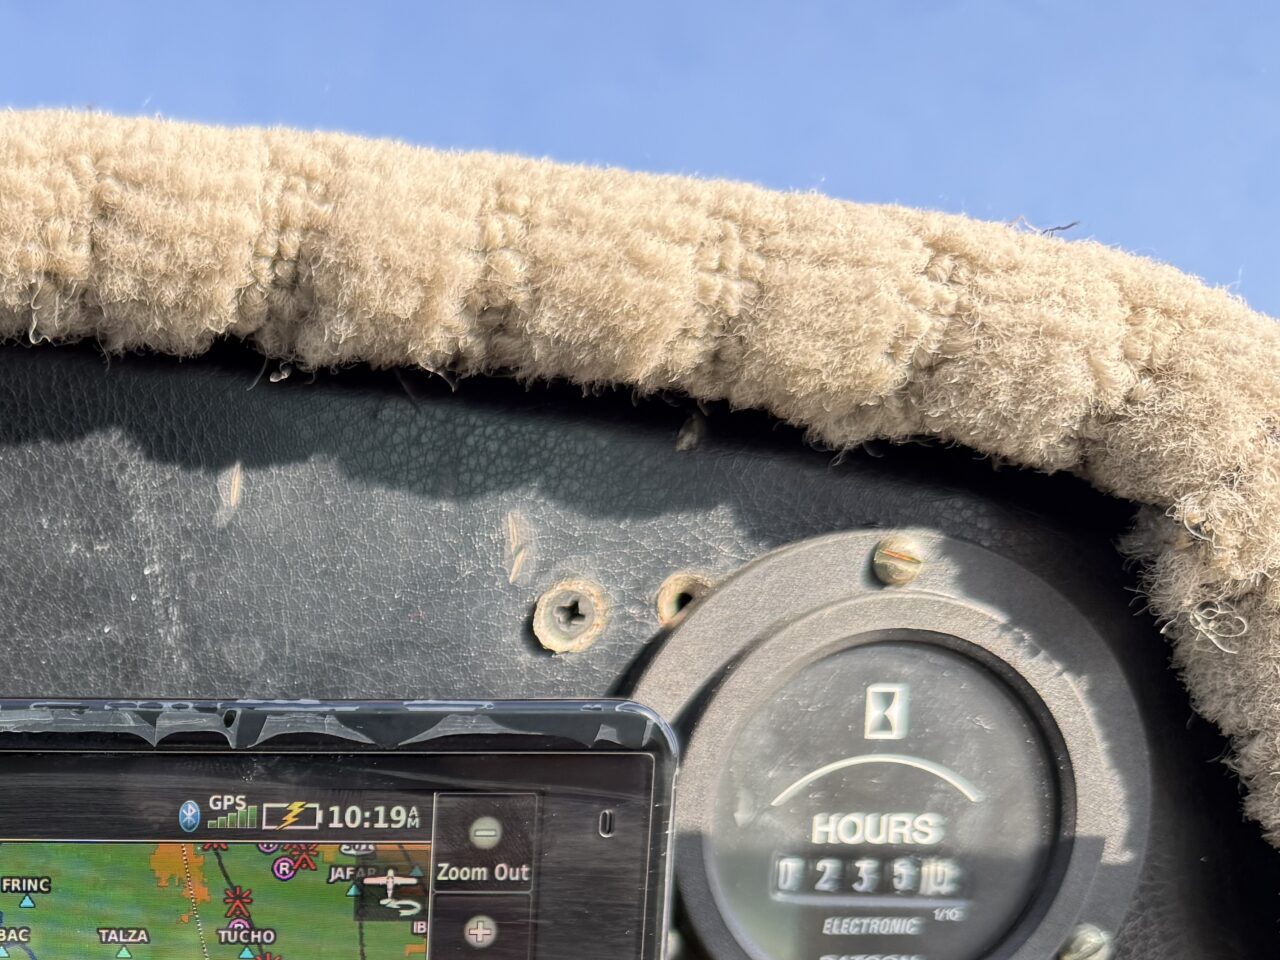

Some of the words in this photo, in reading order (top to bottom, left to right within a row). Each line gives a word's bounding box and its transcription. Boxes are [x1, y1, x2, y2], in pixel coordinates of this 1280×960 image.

[209, 795, 247, 811] GPS
[327, 805, 407, 828] 10:19
[811, 811, 946, 845] HOURS
[436, 863, 488, 881] Zoom
[494, 863, 532, 881] Out
[2, 878, 51, 892] FRINC
[822, 916, 922, 935] ELECTRONIC
[98, 929, 149, 943] TALZA
[218, 929, 276, 943] TUCHO
